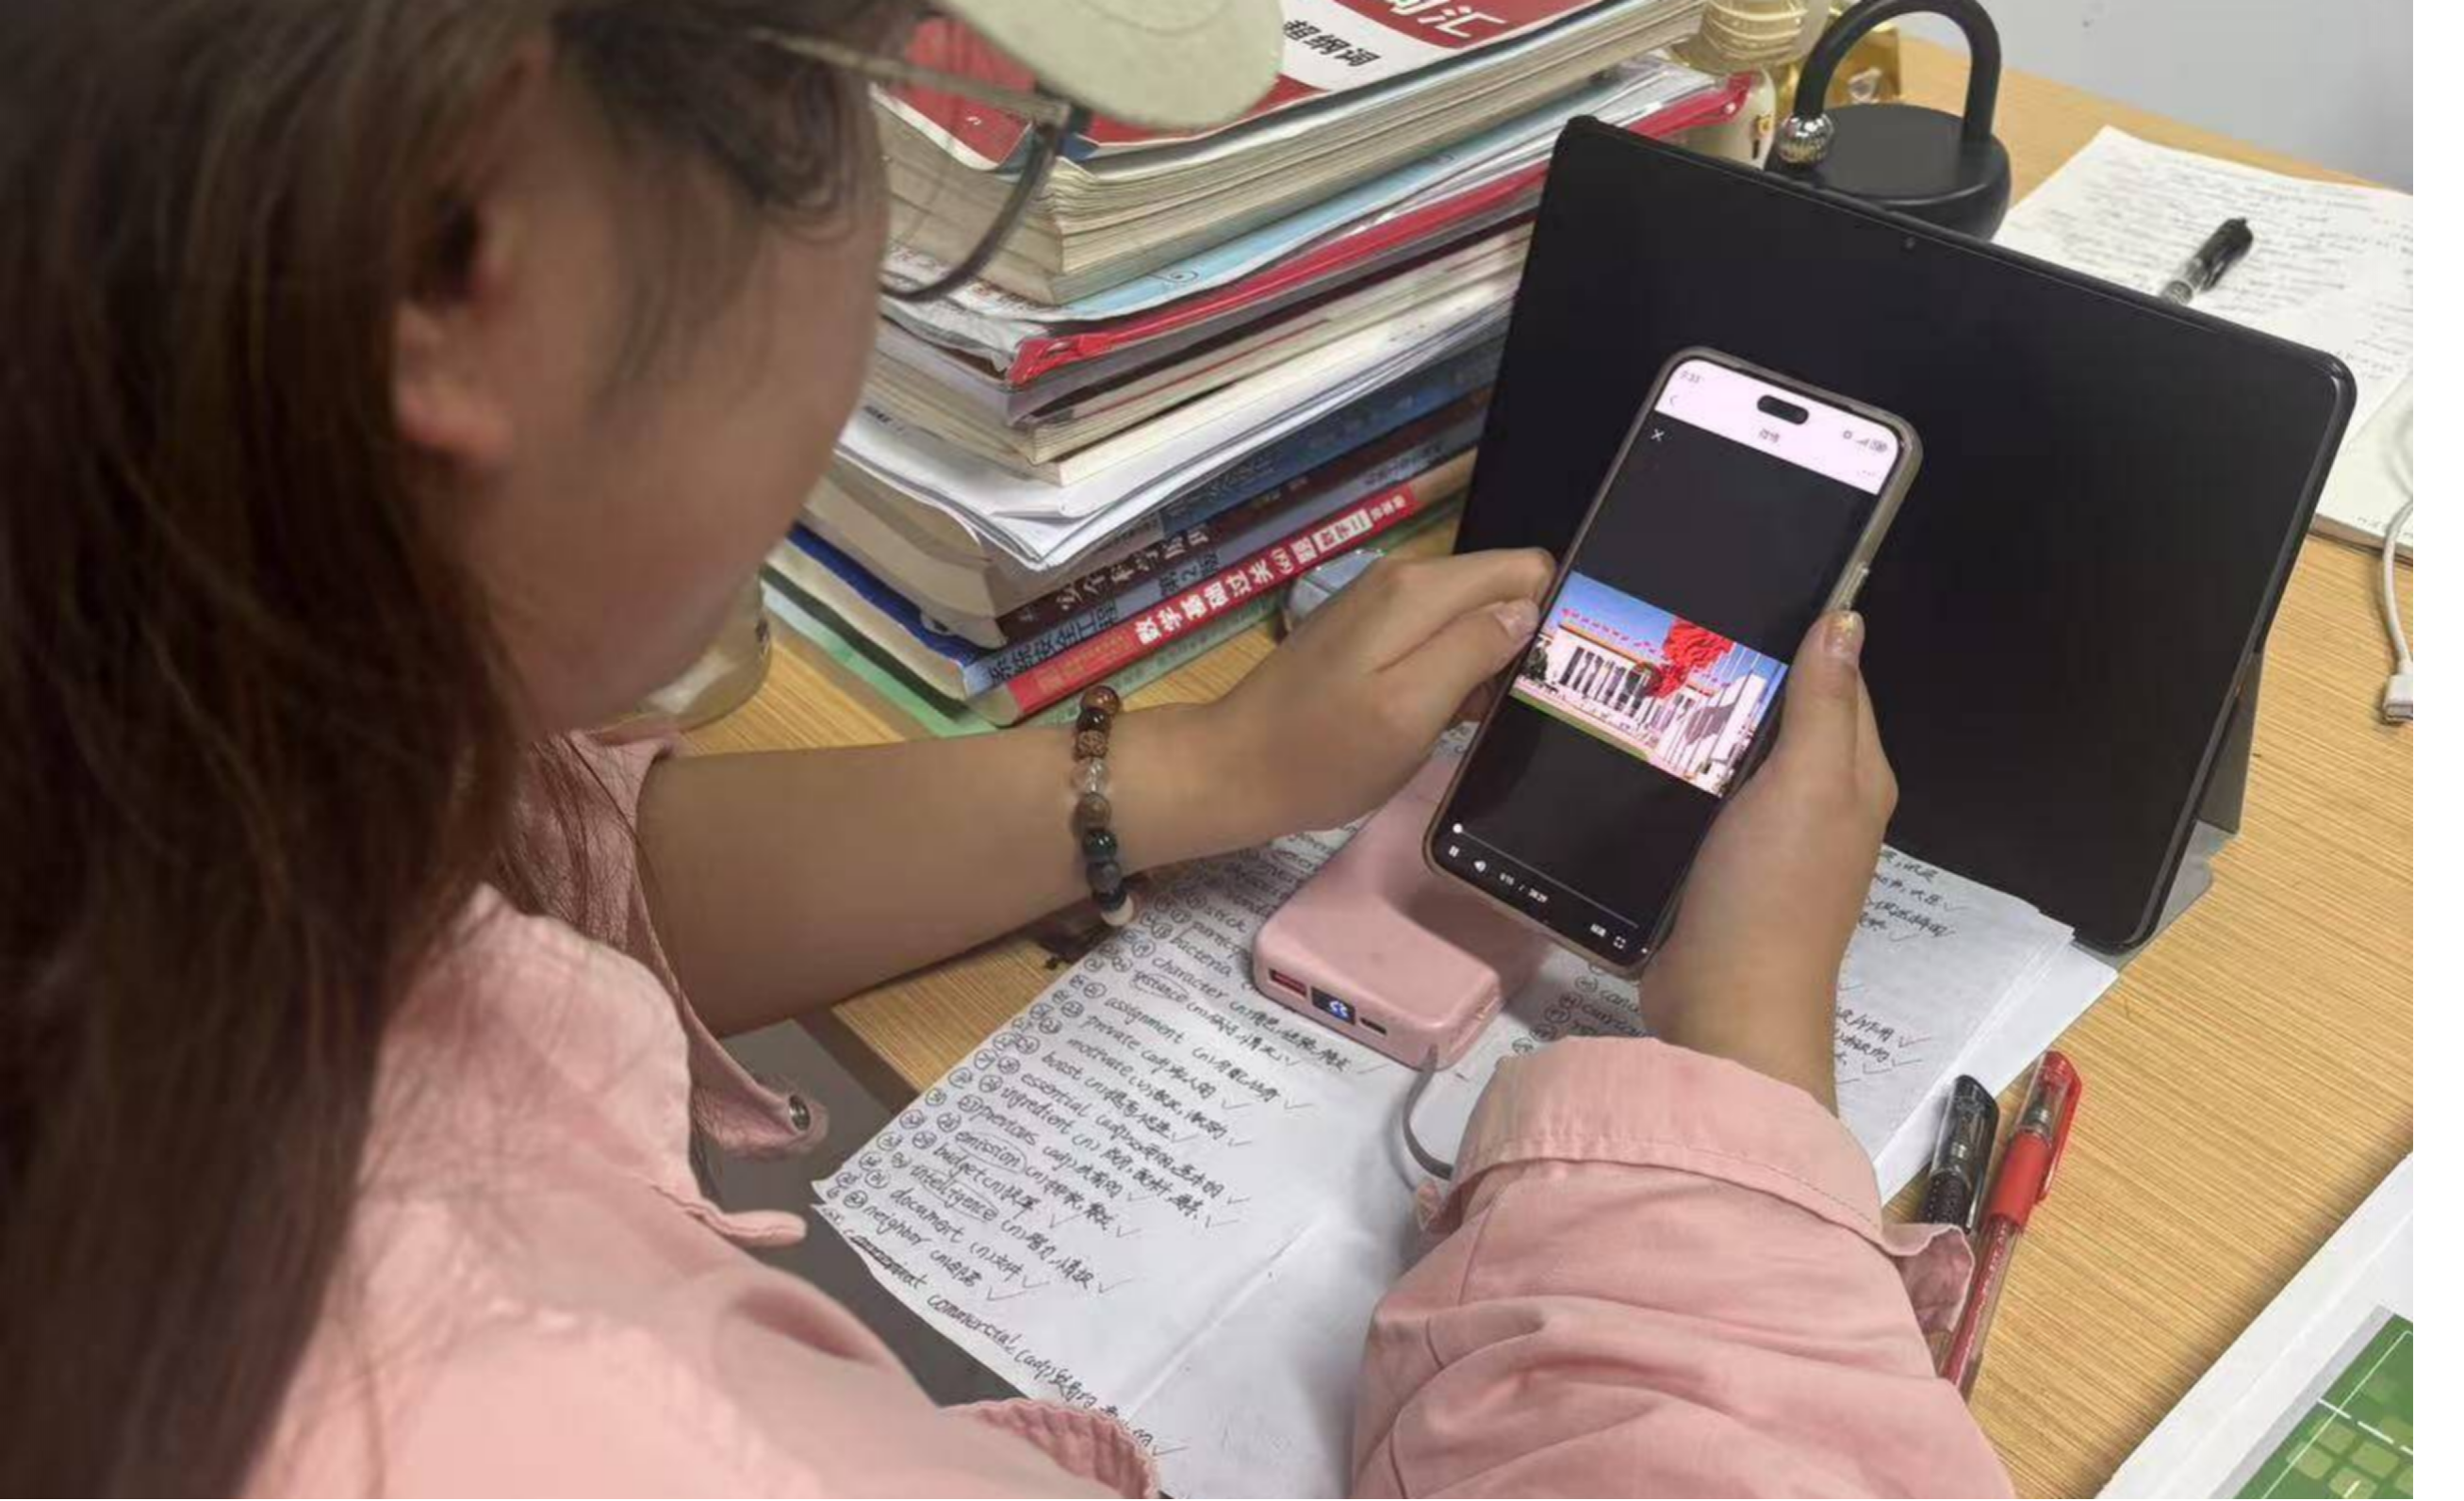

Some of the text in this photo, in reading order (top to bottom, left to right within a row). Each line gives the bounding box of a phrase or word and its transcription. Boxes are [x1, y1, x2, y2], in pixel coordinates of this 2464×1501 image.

[1283, 19, 1381, 67] 超纲词
[1152, 958, 1228, 998] character
[1080, 1015, 1141, 1050] private
[1105, 998, 1184, 1044] assignment
[1067, 1039, 1133, 1077] motivate
[1001, 1088, 1075, 1134] ingredient
[1021, 1074, 1092, 1117] essential
[969, 1100, 1038, 1159] previous
[933, 1143, 986, 1181] budget
[955, 1131, 1020, 1173] emission
[890, 1188, 964, 1243] document
[910, 1165, 998, 1223] intelligence
[862, 1206, 931, 1245] neighbor
[928, 1295, 1022, 1354] commercial
